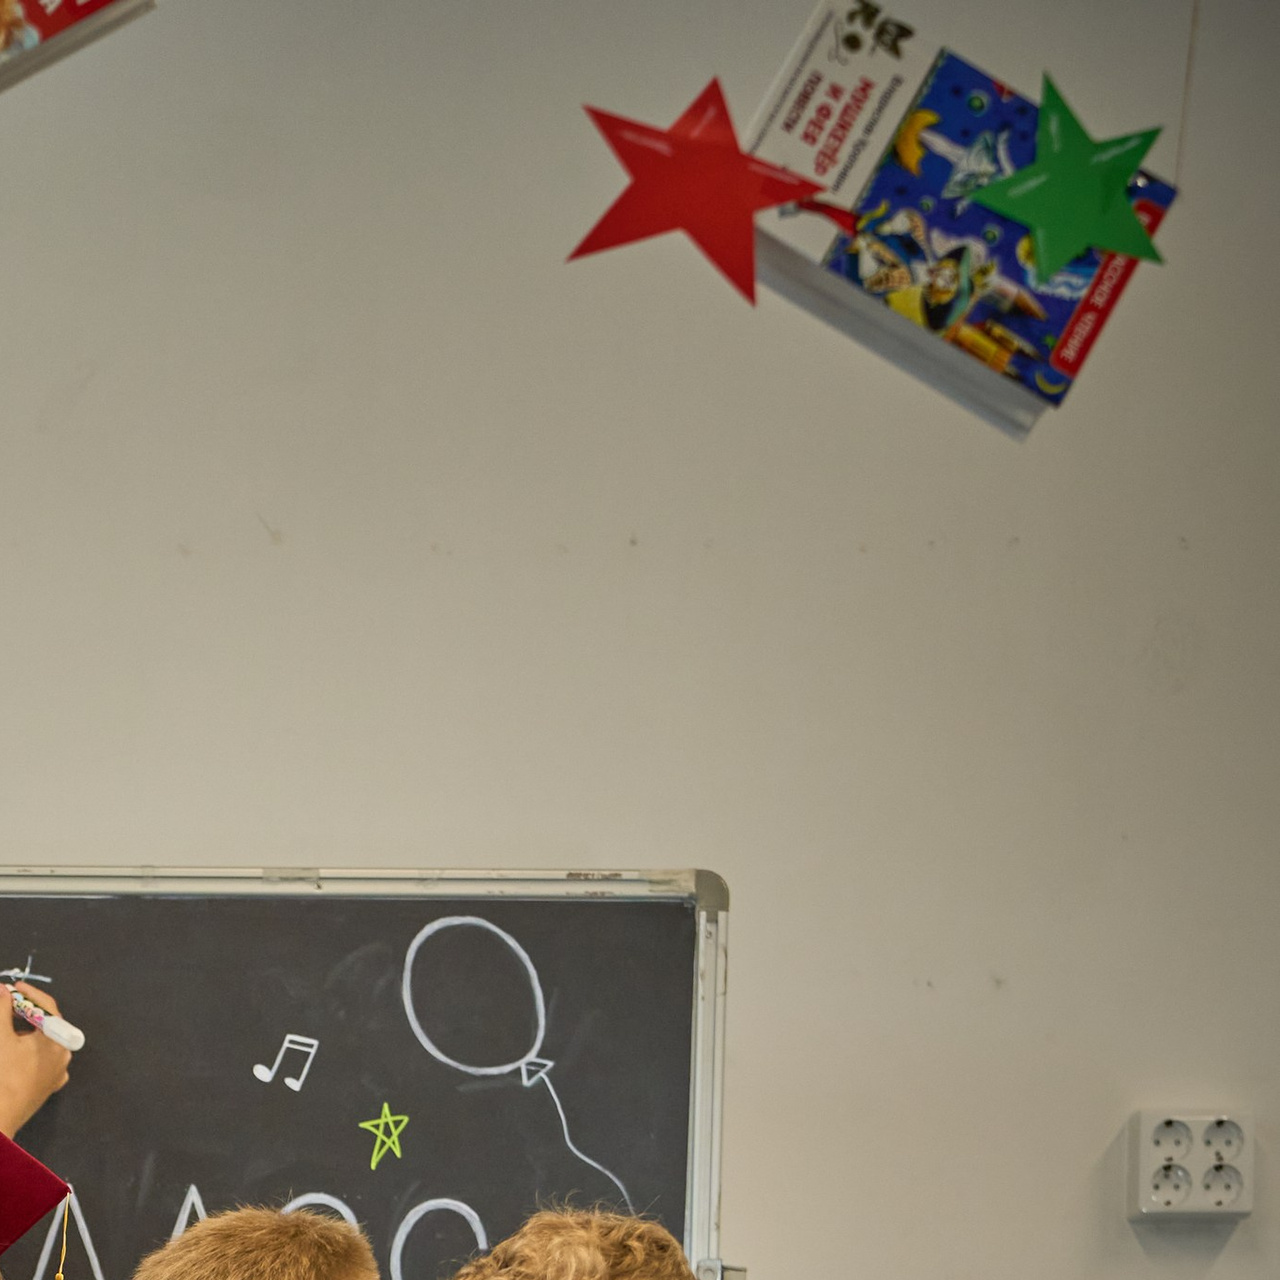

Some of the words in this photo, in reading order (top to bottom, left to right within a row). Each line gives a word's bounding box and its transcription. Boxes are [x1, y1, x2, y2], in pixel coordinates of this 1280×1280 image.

[781, 69, 824, 135] ПОВЕСТИ
[800, 102, 832, 146] ФЕЯ
[814, 76, 876, 177] МУШКЕТЁР
[1060, 310, 1099, 363] ЧТЕНИЕ
